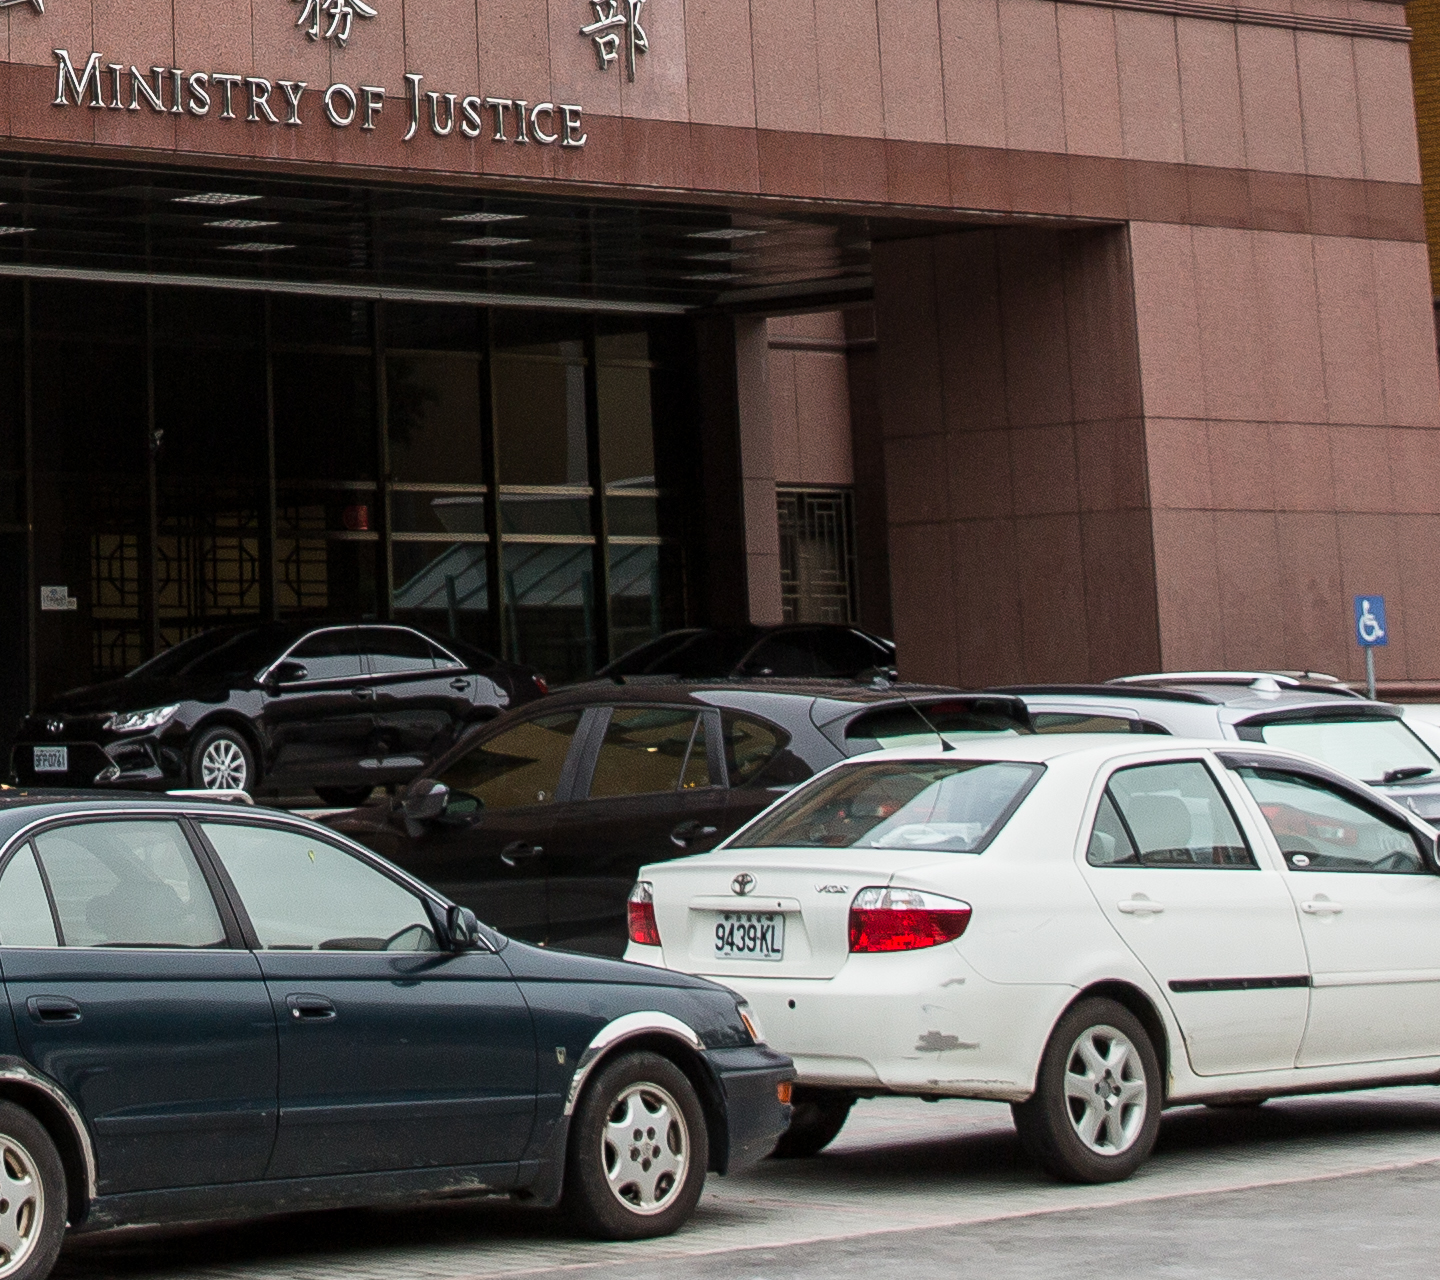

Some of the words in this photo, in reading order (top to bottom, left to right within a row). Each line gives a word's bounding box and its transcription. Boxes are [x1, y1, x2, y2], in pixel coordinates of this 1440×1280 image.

[51, 48, 309, 126] MINISTRY
[323, 81, 387, 130] OF
[402, 72, 589, 148] JUSTICE
[715, 923, 781, 953] 9439-KL
